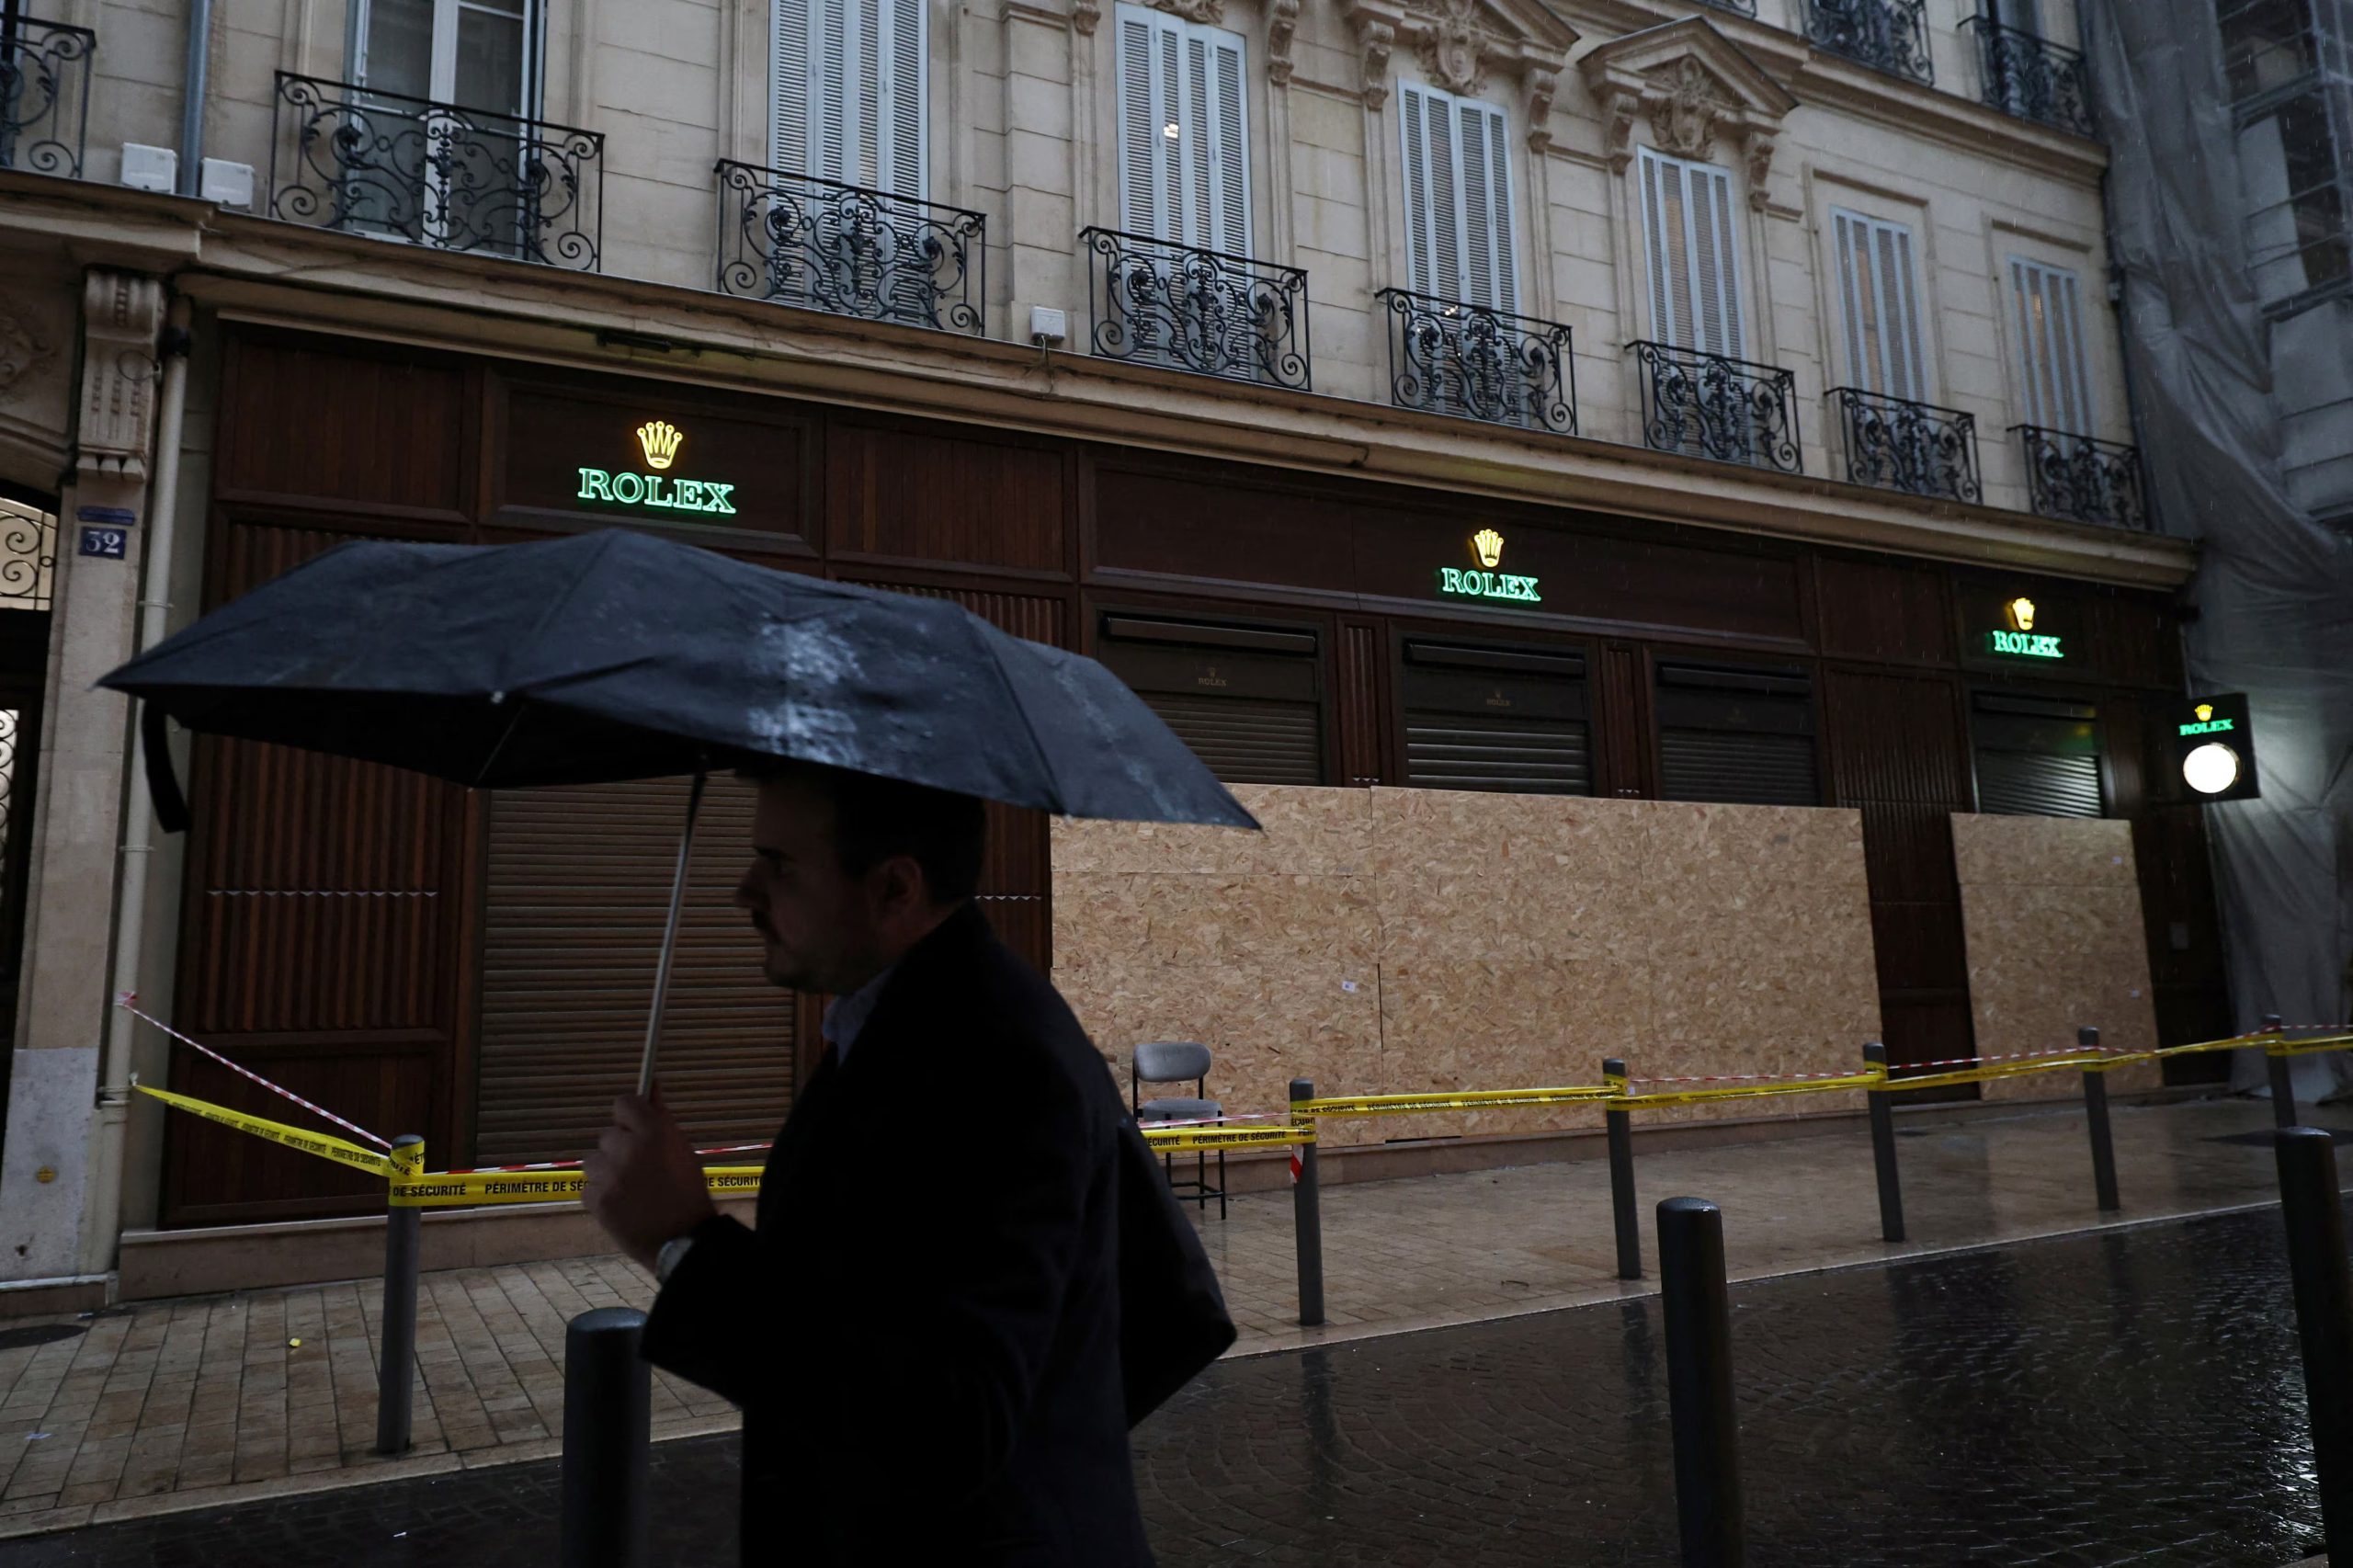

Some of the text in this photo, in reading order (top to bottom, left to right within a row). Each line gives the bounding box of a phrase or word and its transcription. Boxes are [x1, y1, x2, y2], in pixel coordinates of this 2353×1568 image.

[577, 467, 736, 515] ROLEX
[1441, 567, 1540, 601] ROLEX
[1993, 631, 2064, 658] ROLEX
[1198, 676, 1227, 687] ROLEX
[2178, 718, 2234, 736] ROLEX
[1148, 1131, 1286, 1146] ÉCURITÉ PÉRIMÈTRE DE SÉCURITÉ
[392, 1187, 406, 1197] DE
[410, 1182, 466, 1198] SÉCURITÉ
[485, 1179, 548, 1194] PÉRIMÈTRE
[552, 1181, 566, 1192] DE
